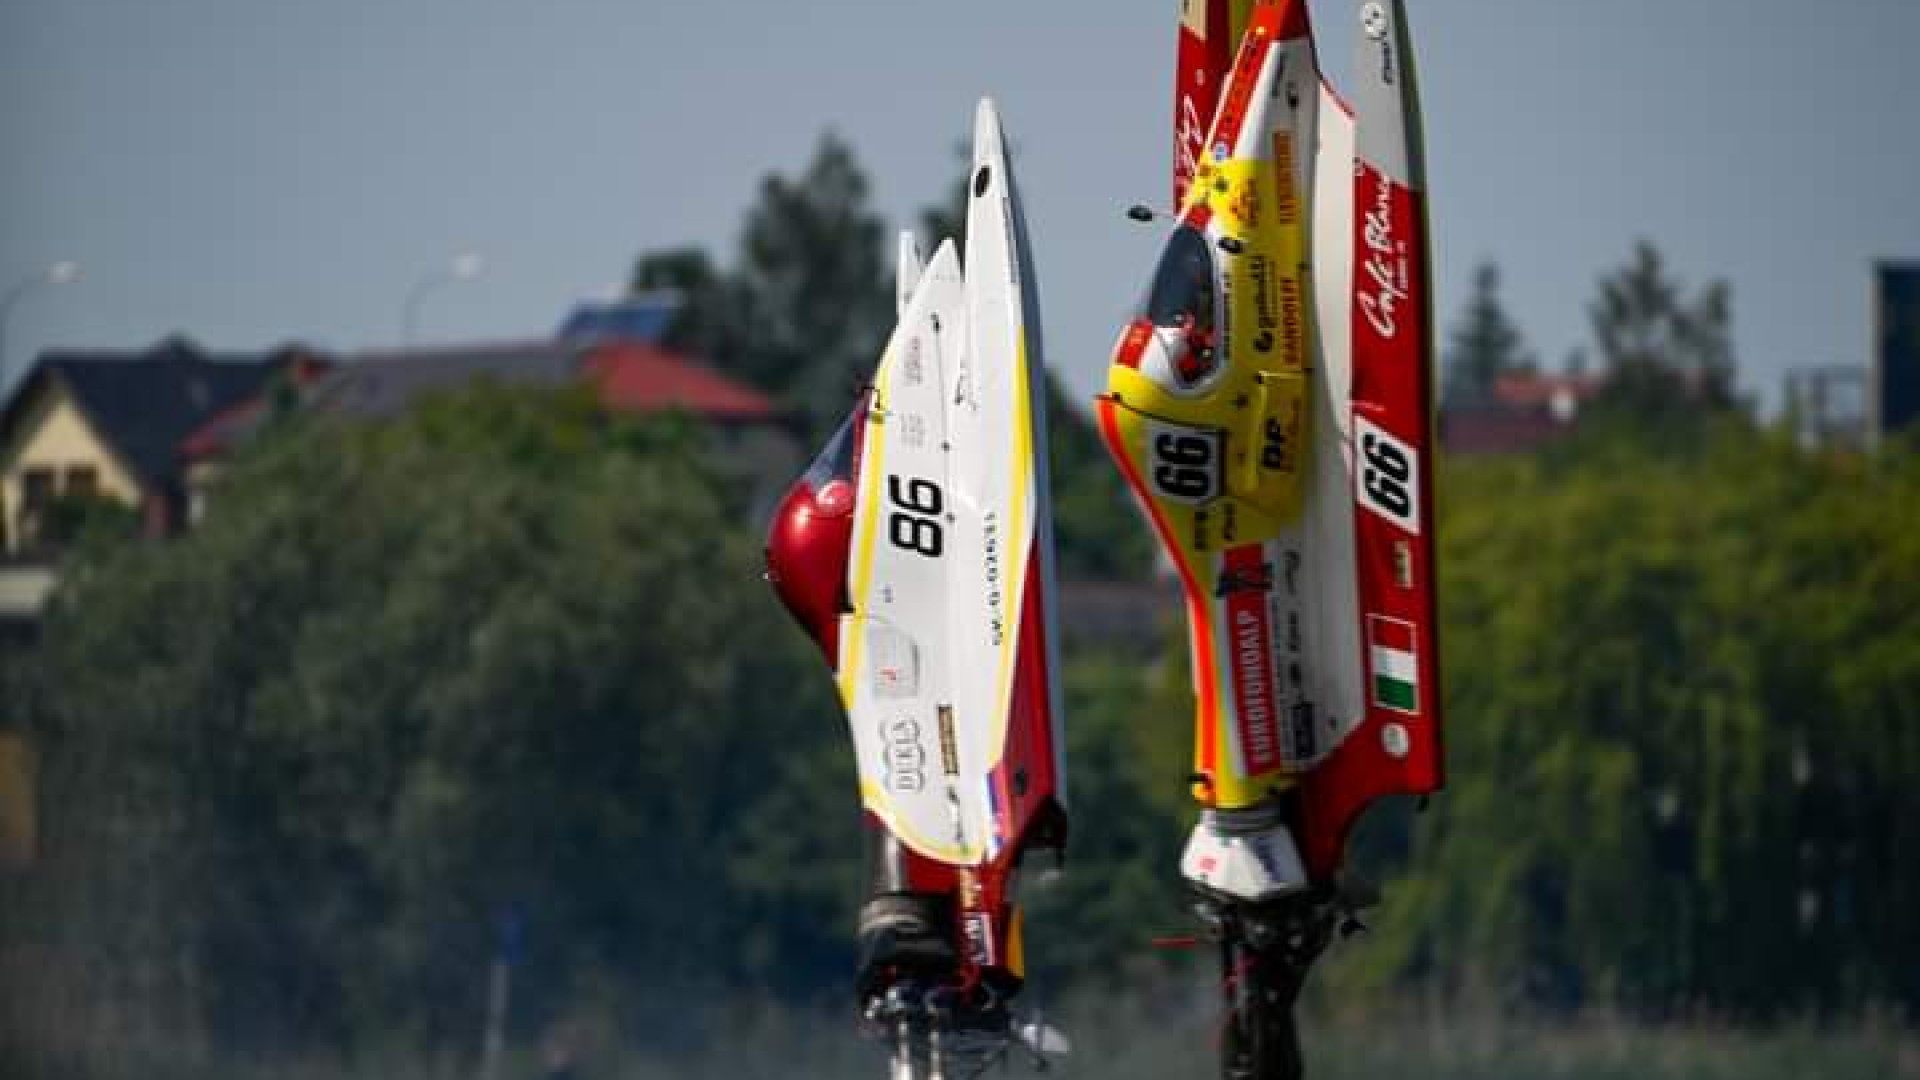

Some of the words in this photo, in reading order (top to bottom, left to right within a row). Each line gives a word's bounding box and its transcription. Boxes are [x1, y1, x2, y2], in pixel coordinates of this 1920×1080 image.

[1155, 433, 1209, 497] 66
[1362, 433, 1409, 518] 66
[887, 475, 943, 559] 86
